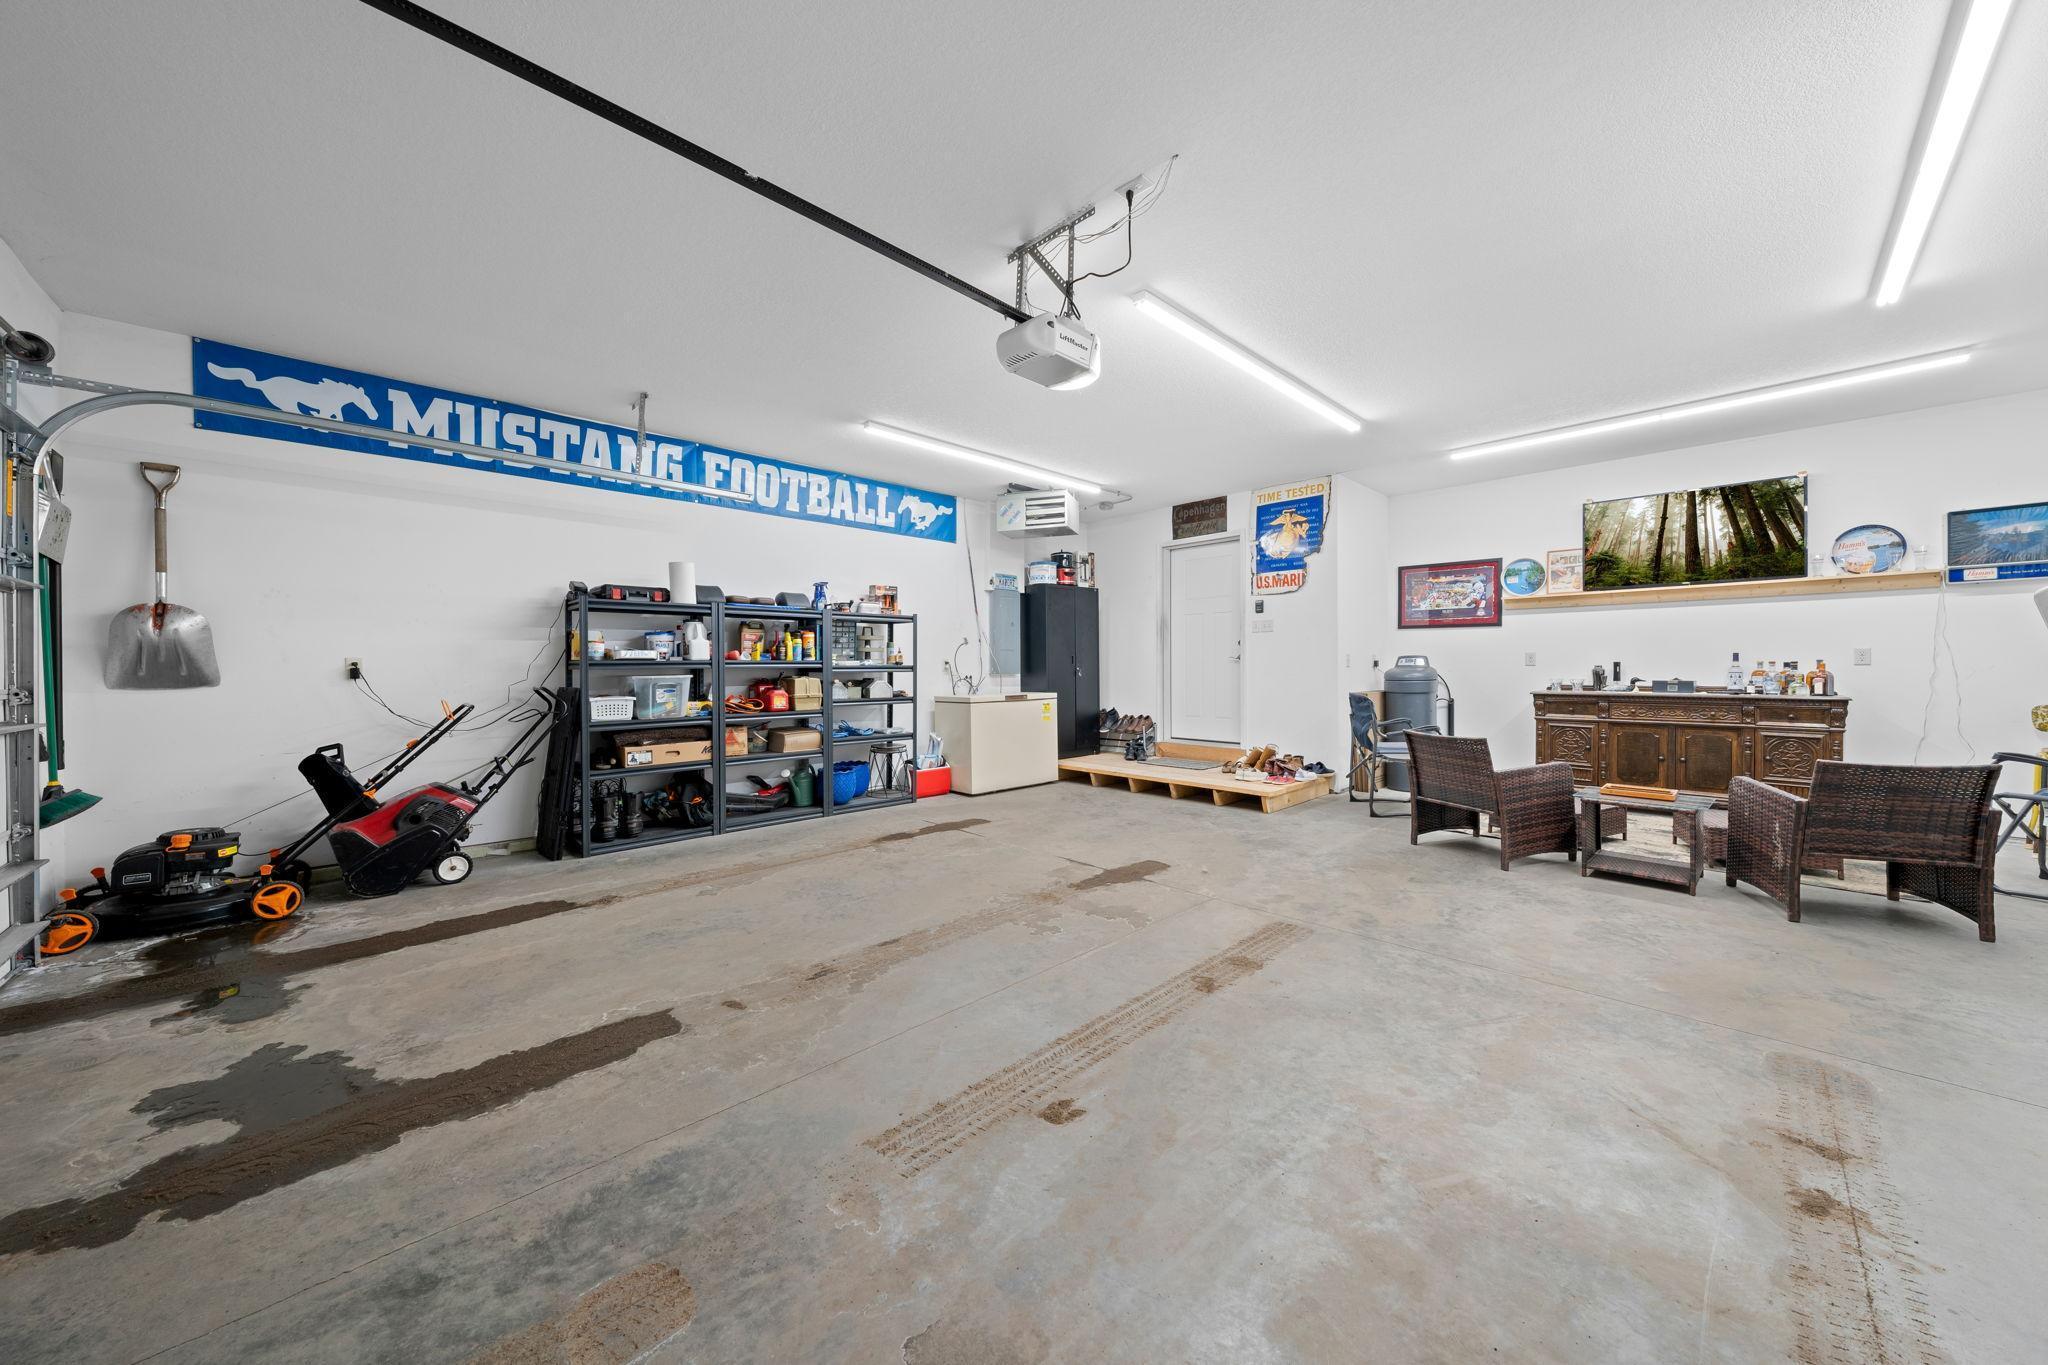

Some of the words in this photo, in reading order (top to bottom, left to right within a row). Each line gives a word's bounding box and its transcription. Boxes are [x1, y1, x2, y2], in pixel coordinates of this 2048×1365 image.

[1060, 332, 1088, 351] LiftMaster
[387, 388, 685, 493] MUSTANG
[702, 450, 895, 528] FOOTBALL
[1257, 490, 1282, 503] TIME
[1285, 483, 1325, 499] TESTED
[1173, 502, 1226, 523] Copenhagen
[1838, 539, 1867, 550] Hamm's
